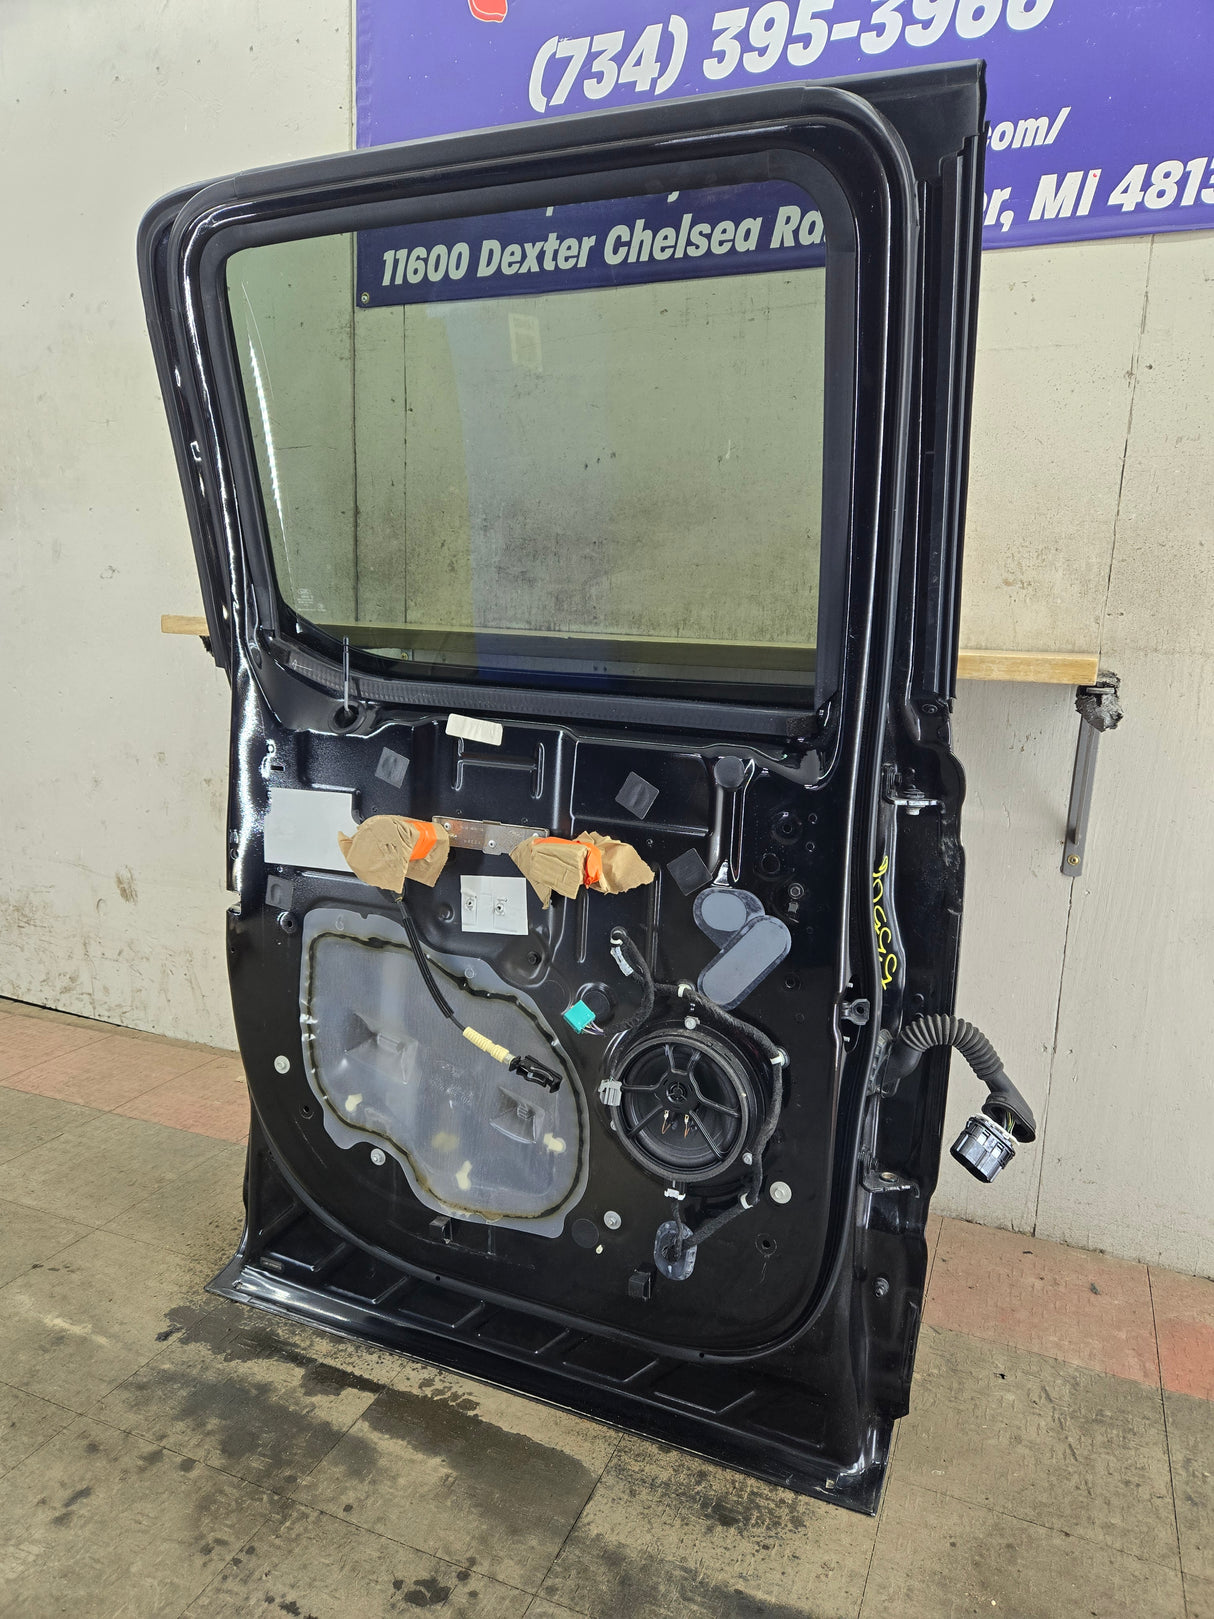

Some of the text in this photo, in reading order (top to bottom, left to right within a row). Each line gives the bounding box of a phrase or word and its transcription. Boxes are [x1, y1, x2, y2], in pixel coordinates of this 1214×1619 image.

[528, 14, 688, 113] (734)
[1028, 168, 1102, 221] MI
[381, 241, 470, 287] 11600
[476, 232, 597, 278] Dexter
[603, 212, 763, 265] Chelsea
